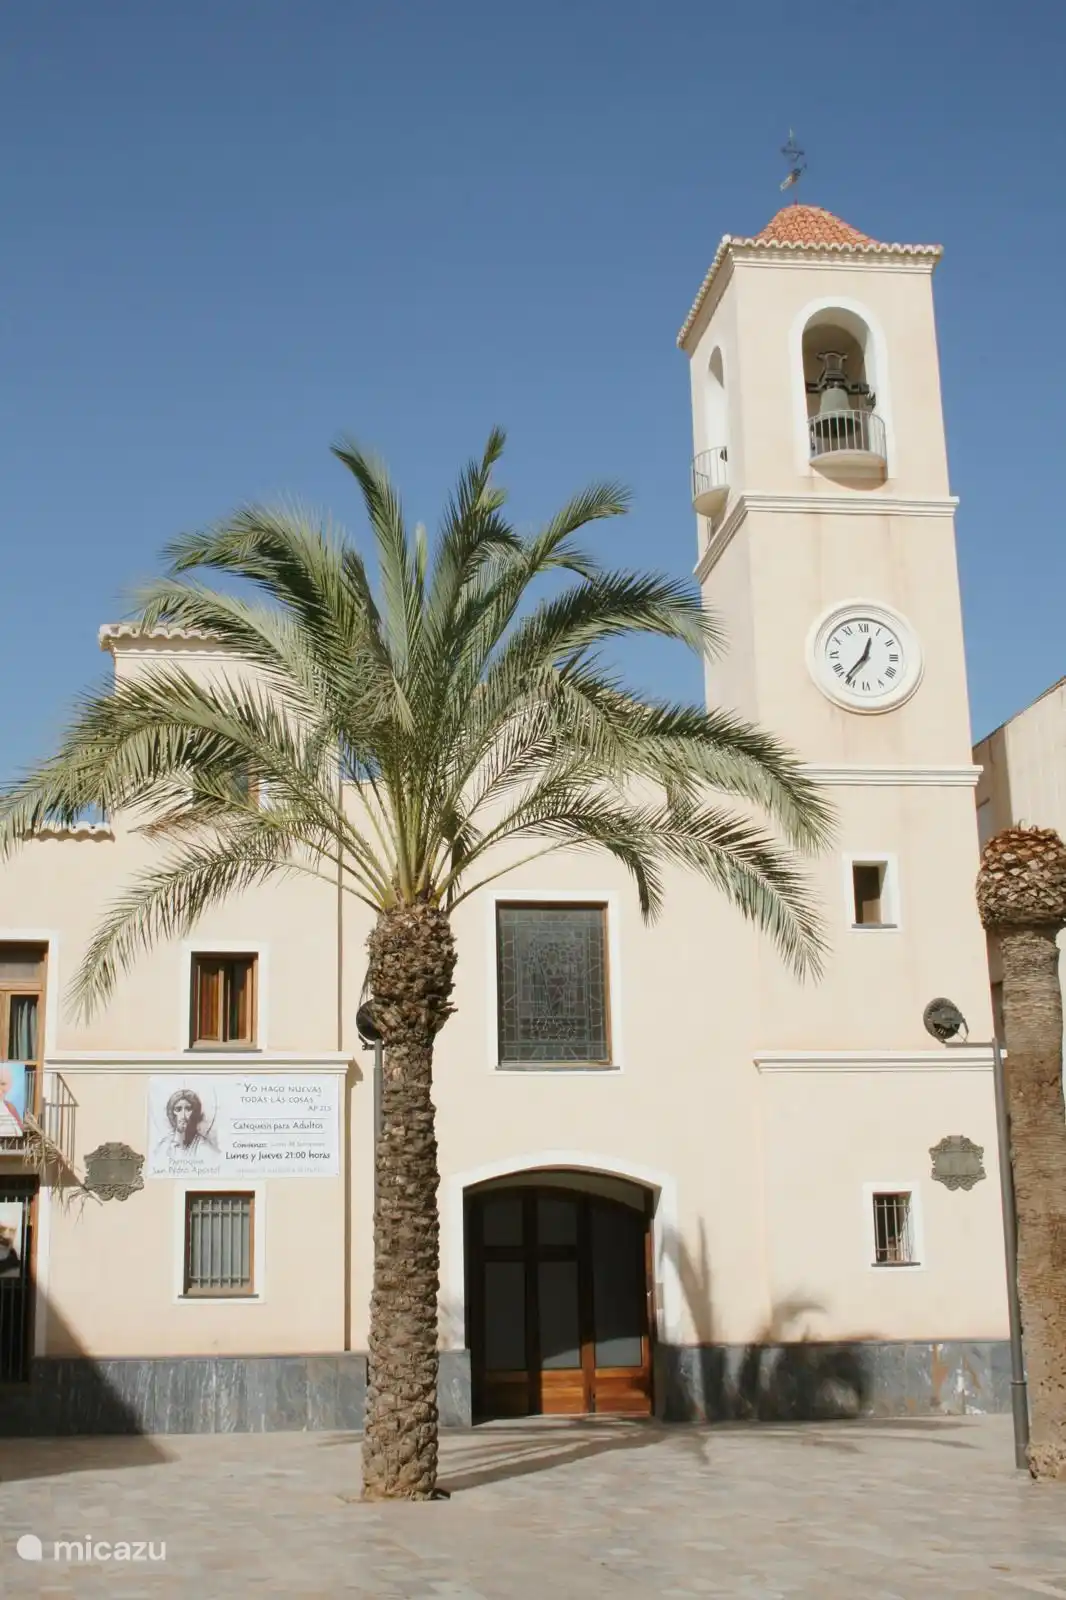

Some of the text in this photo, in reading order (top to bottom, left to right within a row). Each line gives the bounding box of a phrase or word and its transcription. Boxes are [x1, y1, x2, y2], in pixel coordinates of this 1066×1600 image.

[858, 623, 869, 633] XII
[884, 639, 895, 647] II
[889, 653, 899, 662] III
[273, 1123, 290, 1133] para
[292, 1120, 324, 1129] Adultos
[225, 1150, 331, 1163] Lunes y Jueves 21:00 horas
